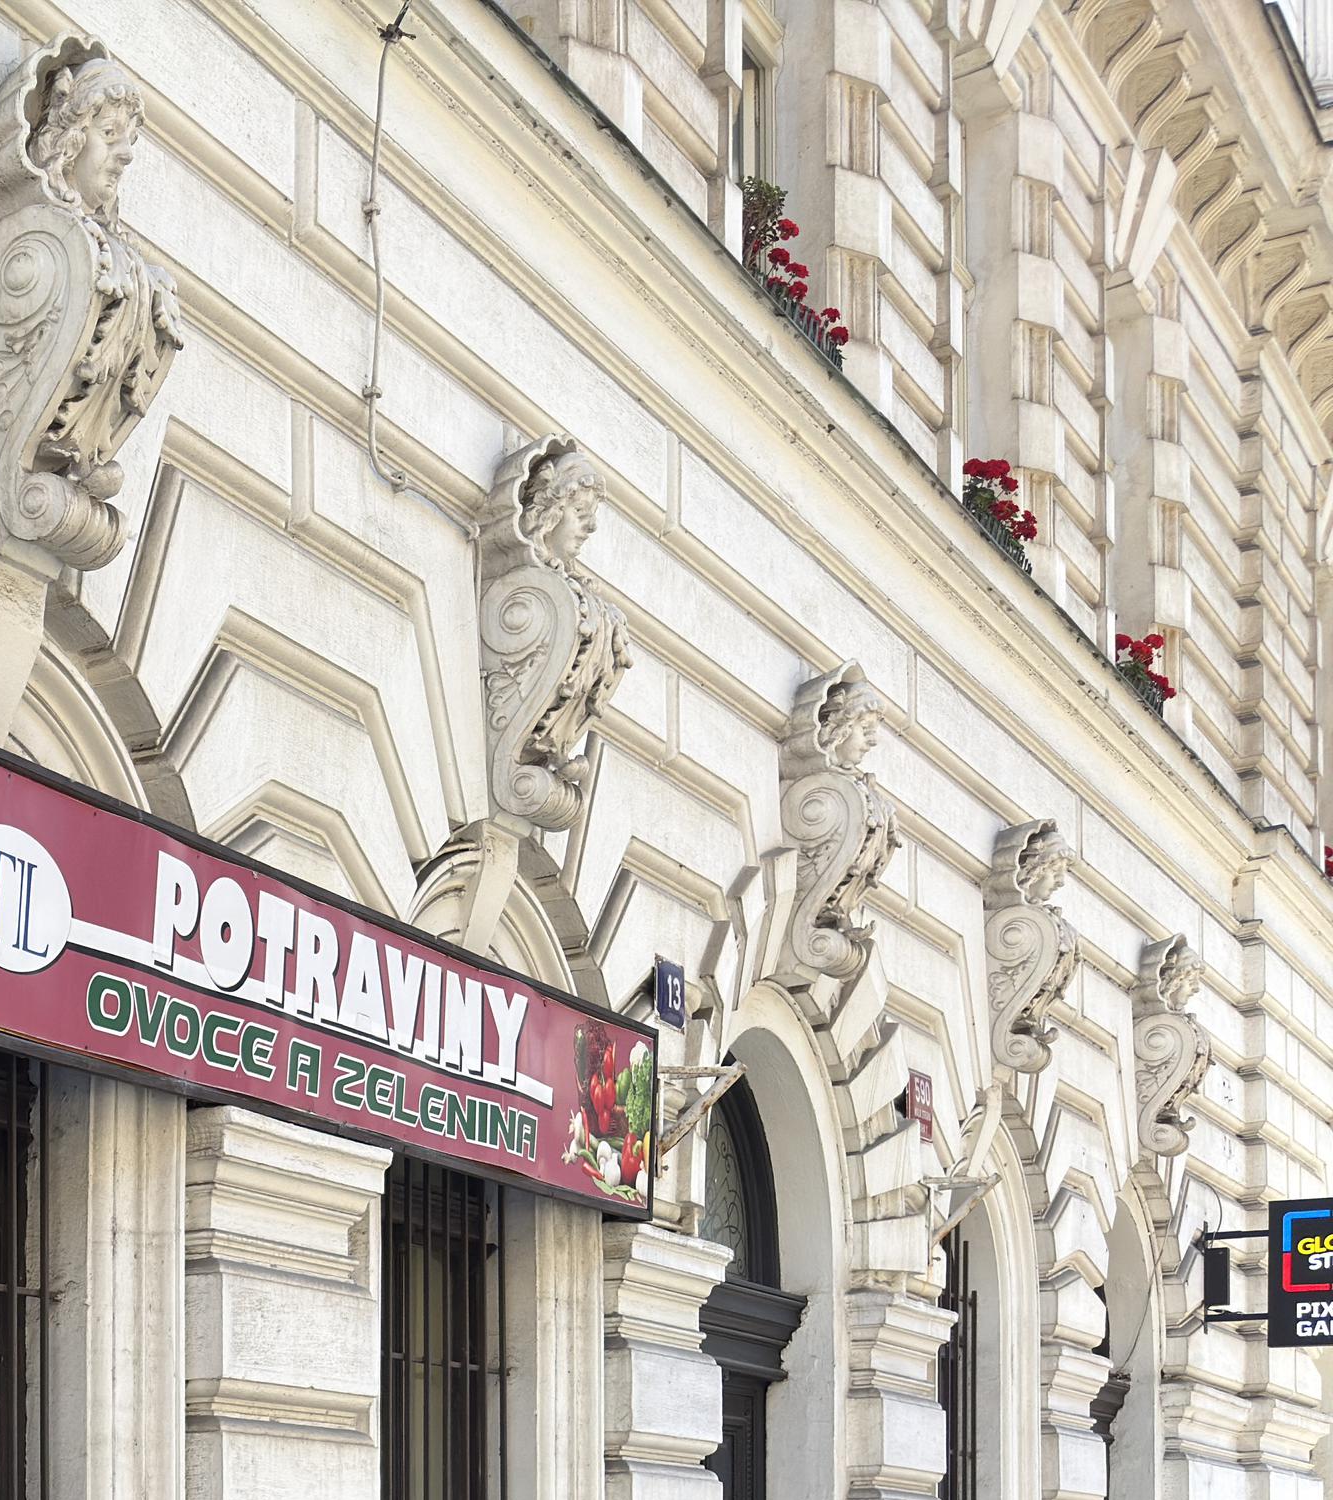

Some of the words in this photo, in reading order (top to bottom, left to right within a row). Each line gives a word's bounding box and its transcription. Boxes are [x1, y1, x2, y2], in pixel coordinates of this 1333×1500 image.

[152, 850, 528, 1087] POTRAVINY
[667, 974, 682, 1012] 13
[87, 971, 278, 1082] OVOCE
[286, 1036, 322, 1098] A
[332, 1055, 539, 1162] ZELENINA
[914, 1076, 931, 1107] 590
[1308, 1252, 1333, 1270] ST
[1296, 1320, 1333, 1337] GA
